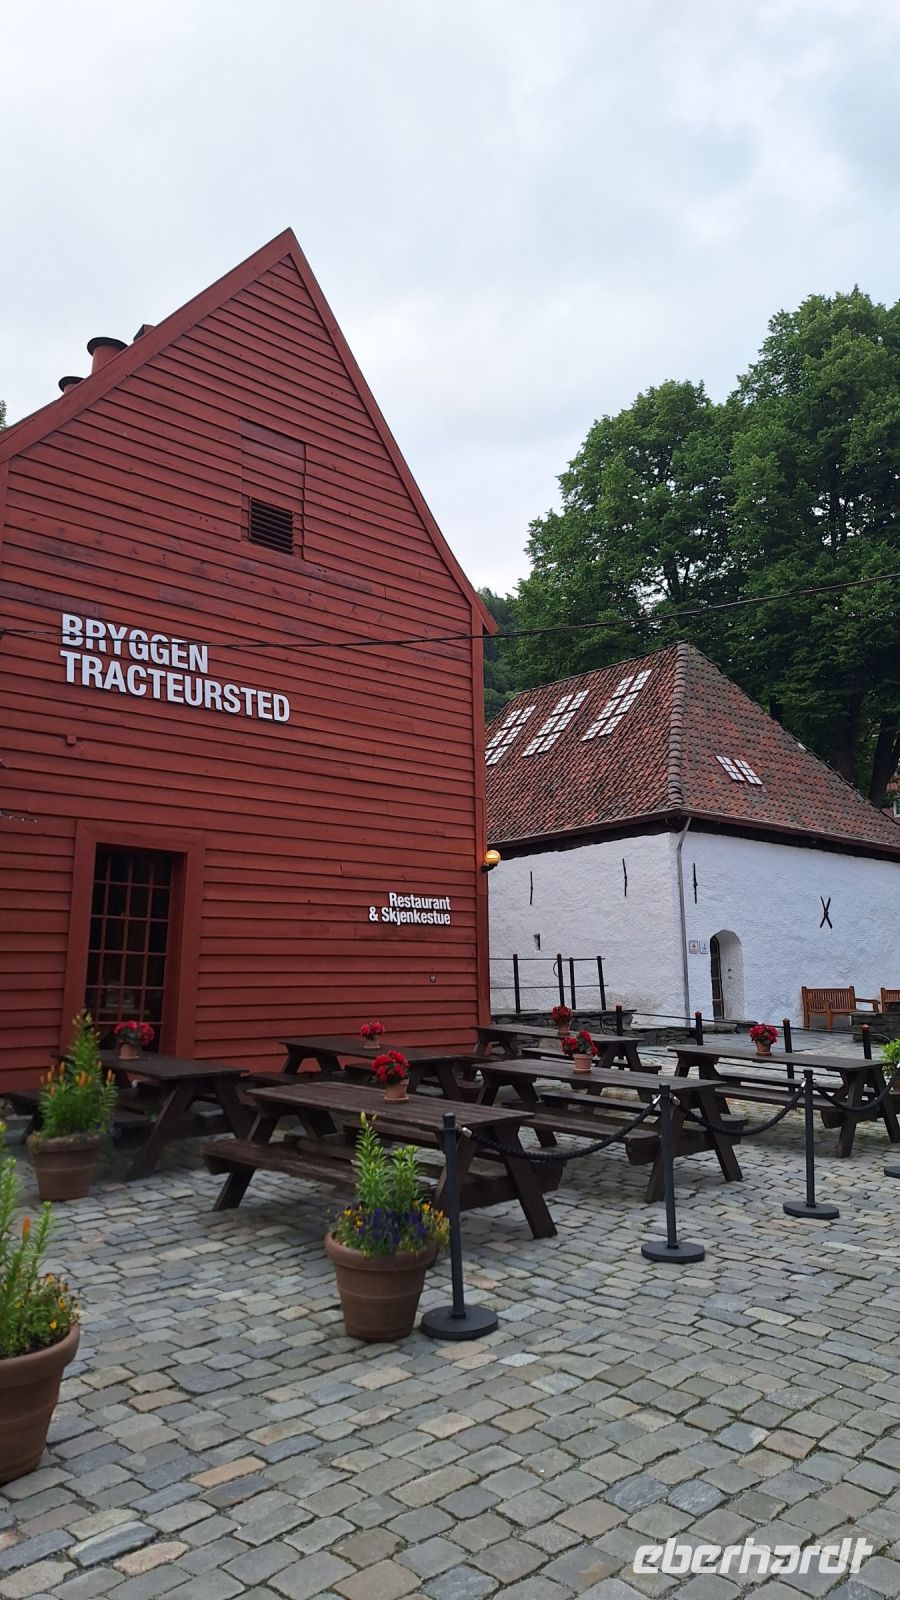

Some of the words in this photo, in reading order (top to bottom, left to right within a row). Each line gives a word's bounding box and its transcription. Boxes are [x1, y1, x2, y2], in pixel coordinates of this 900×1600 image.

[62, 613, 208, 673] BRYGGEN
[60, 651, 290, 722] TRACTEURSTED
[369, 906, 379, 922] &
[381, 907, 451, 925] Skjenkestue
[389, 892, 451, 910] Restaurant
